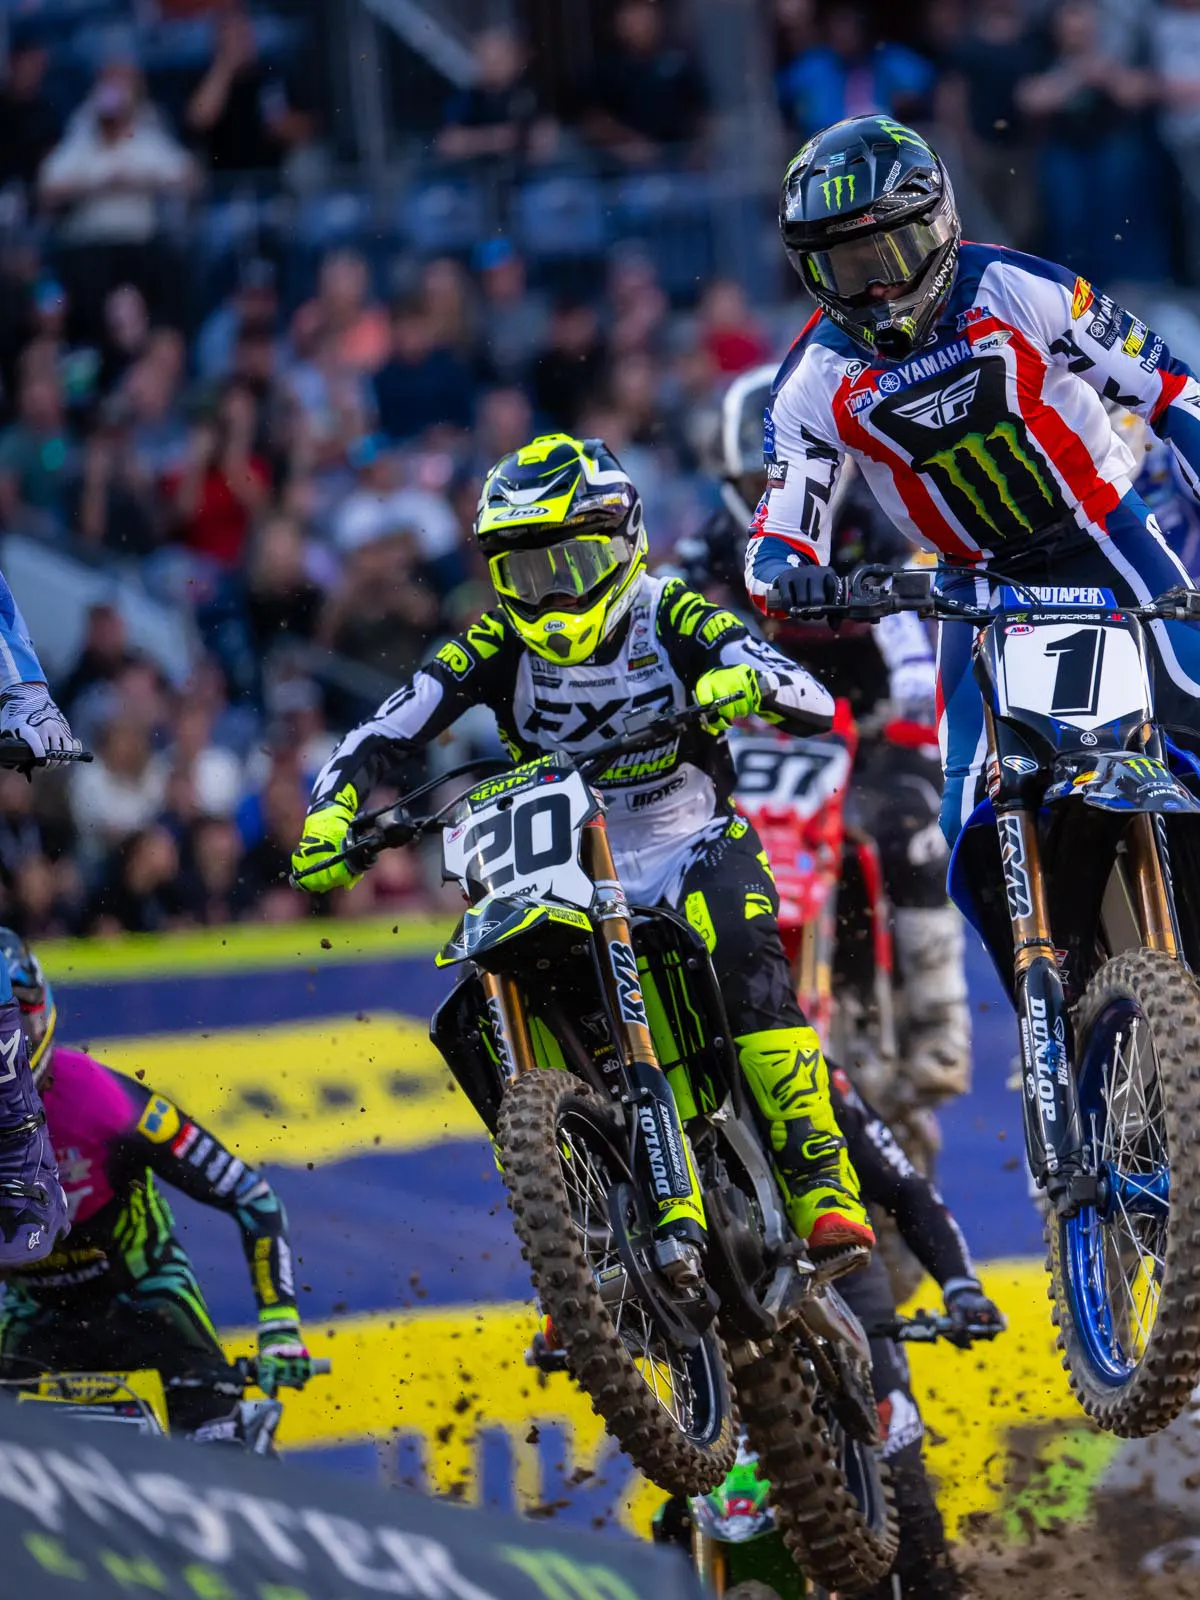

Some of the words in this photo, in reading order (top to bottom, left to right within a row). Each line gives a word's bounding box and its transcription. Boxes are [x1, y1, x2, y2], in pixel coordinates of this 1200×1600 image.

[898, 339, 972, 386] YAMAHA
[506, 506, 544, 522] Arai
[1032, 613, 1101, 623] SUPERCROSS
[1043, 627, 1106, 716] 1
[597, 755, 677, 782] ACING
[463, 792, 573, 890] 20
[1030, 995, 1056, 1122] DUNLOP
